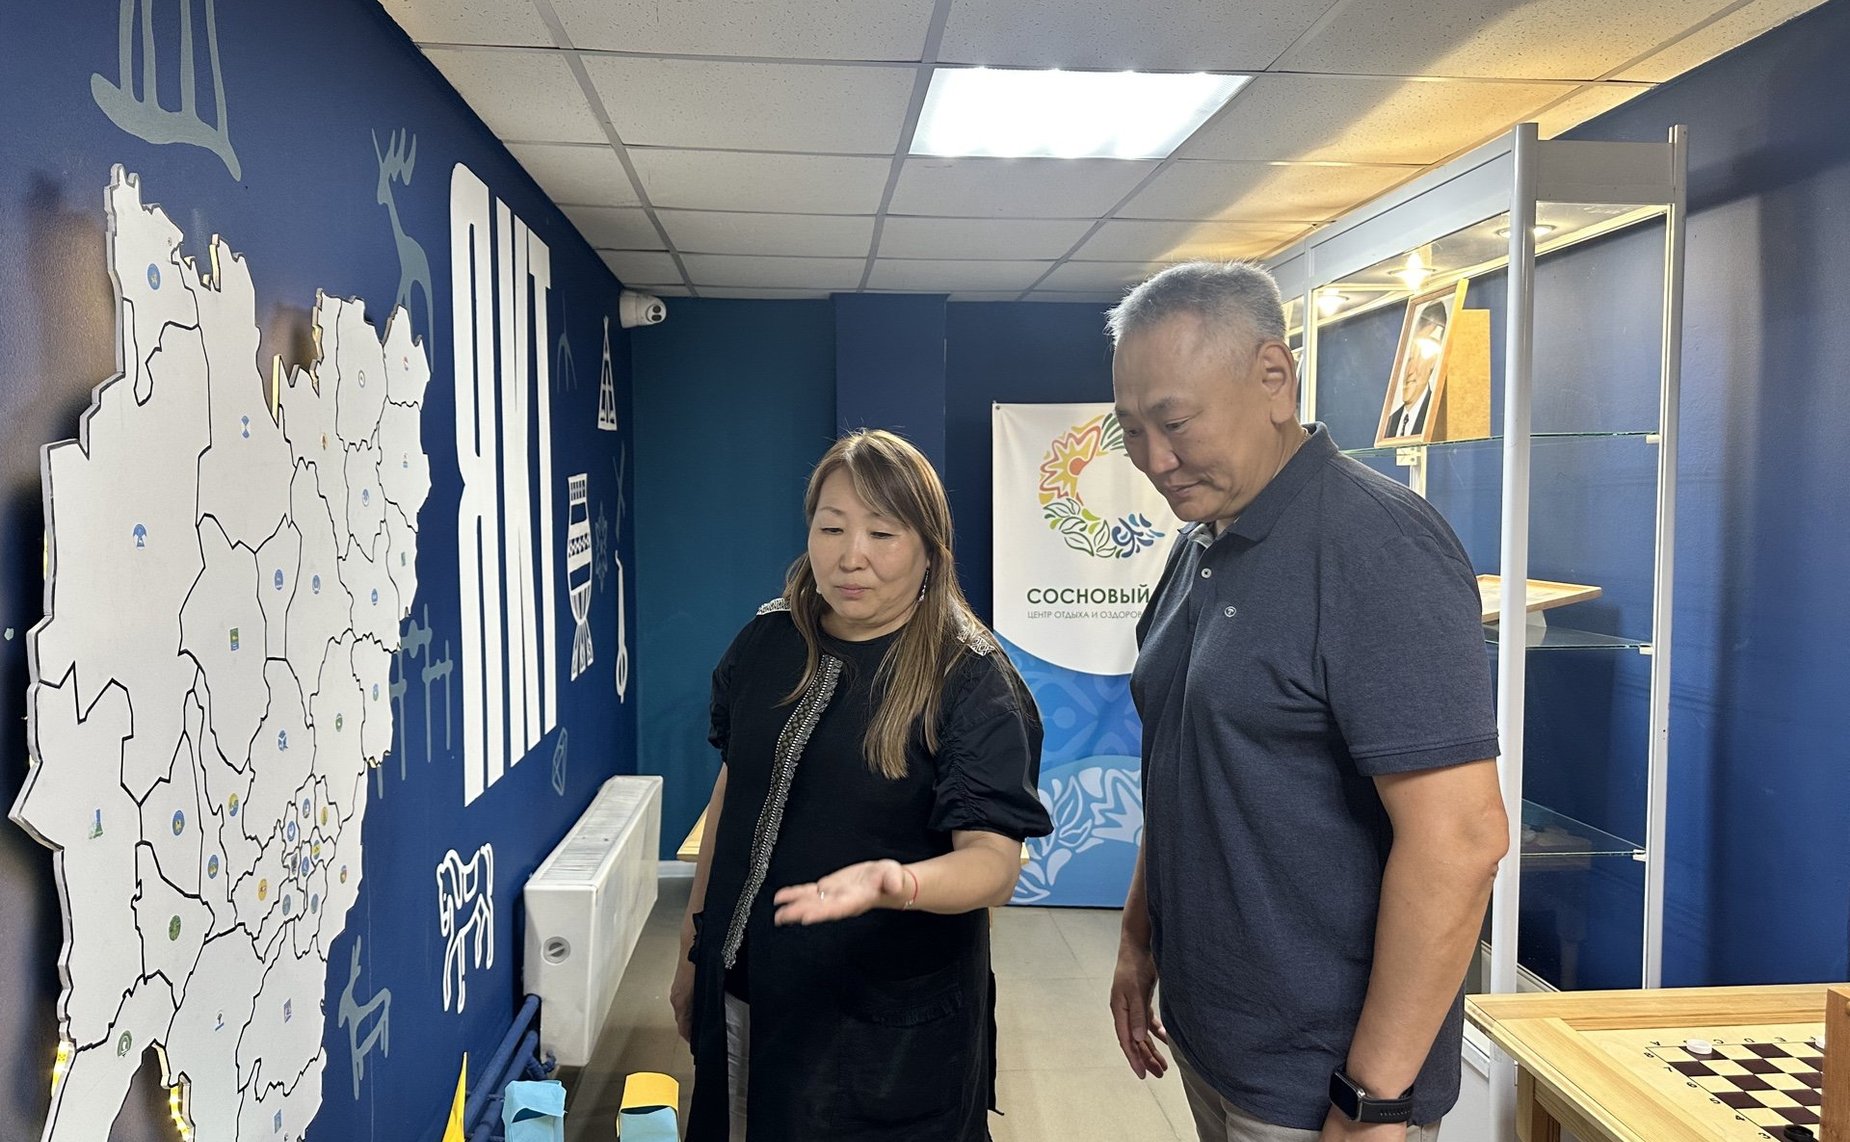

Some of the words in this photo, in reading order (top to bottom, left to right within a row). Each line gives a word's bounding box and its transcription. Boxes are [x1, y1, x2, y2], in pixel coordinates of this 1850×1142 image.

[1027, 584, 1150, 604] СОСНОВЫЙ
[1027, 611, 1052, 619] ЦЕНТР
[1054, 611, 1089, 619] ОТДЫХА
[1091, 611, 1098, 619] И
